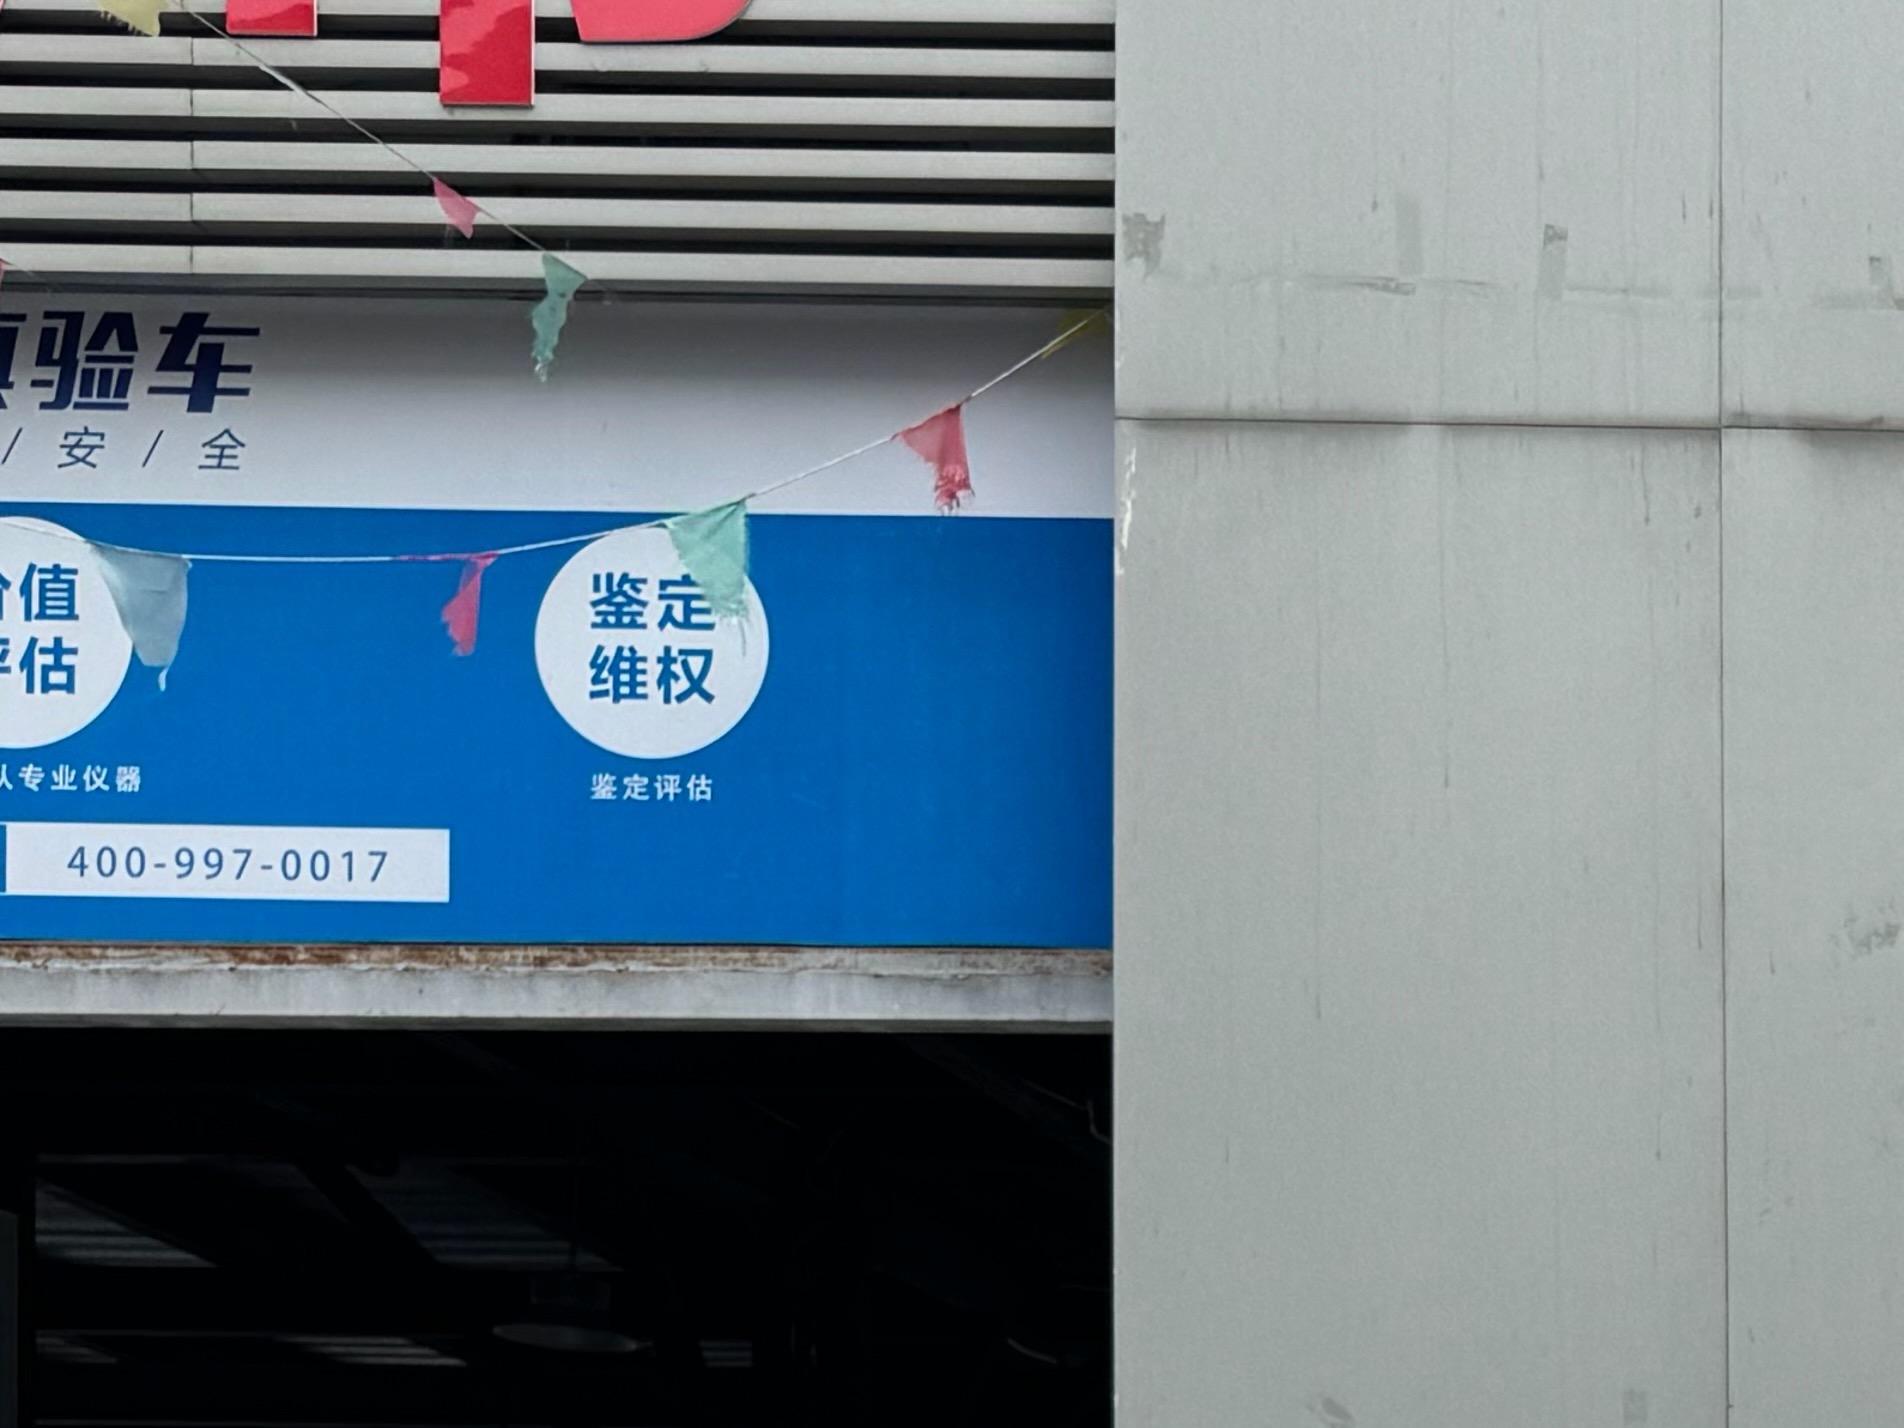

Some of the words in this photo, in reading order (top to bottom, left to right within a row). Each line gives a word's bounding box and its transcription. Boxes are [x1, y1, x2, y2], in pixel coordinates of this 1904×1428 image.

[0, 562, 80, 622] 值
[589, 572, 716, 631] 鉴定
[589, 644, 716, 705] 维权
[590, 773, 713, 801] 鉴定评估
[66, 845, 389, 883] 400-997-0017
